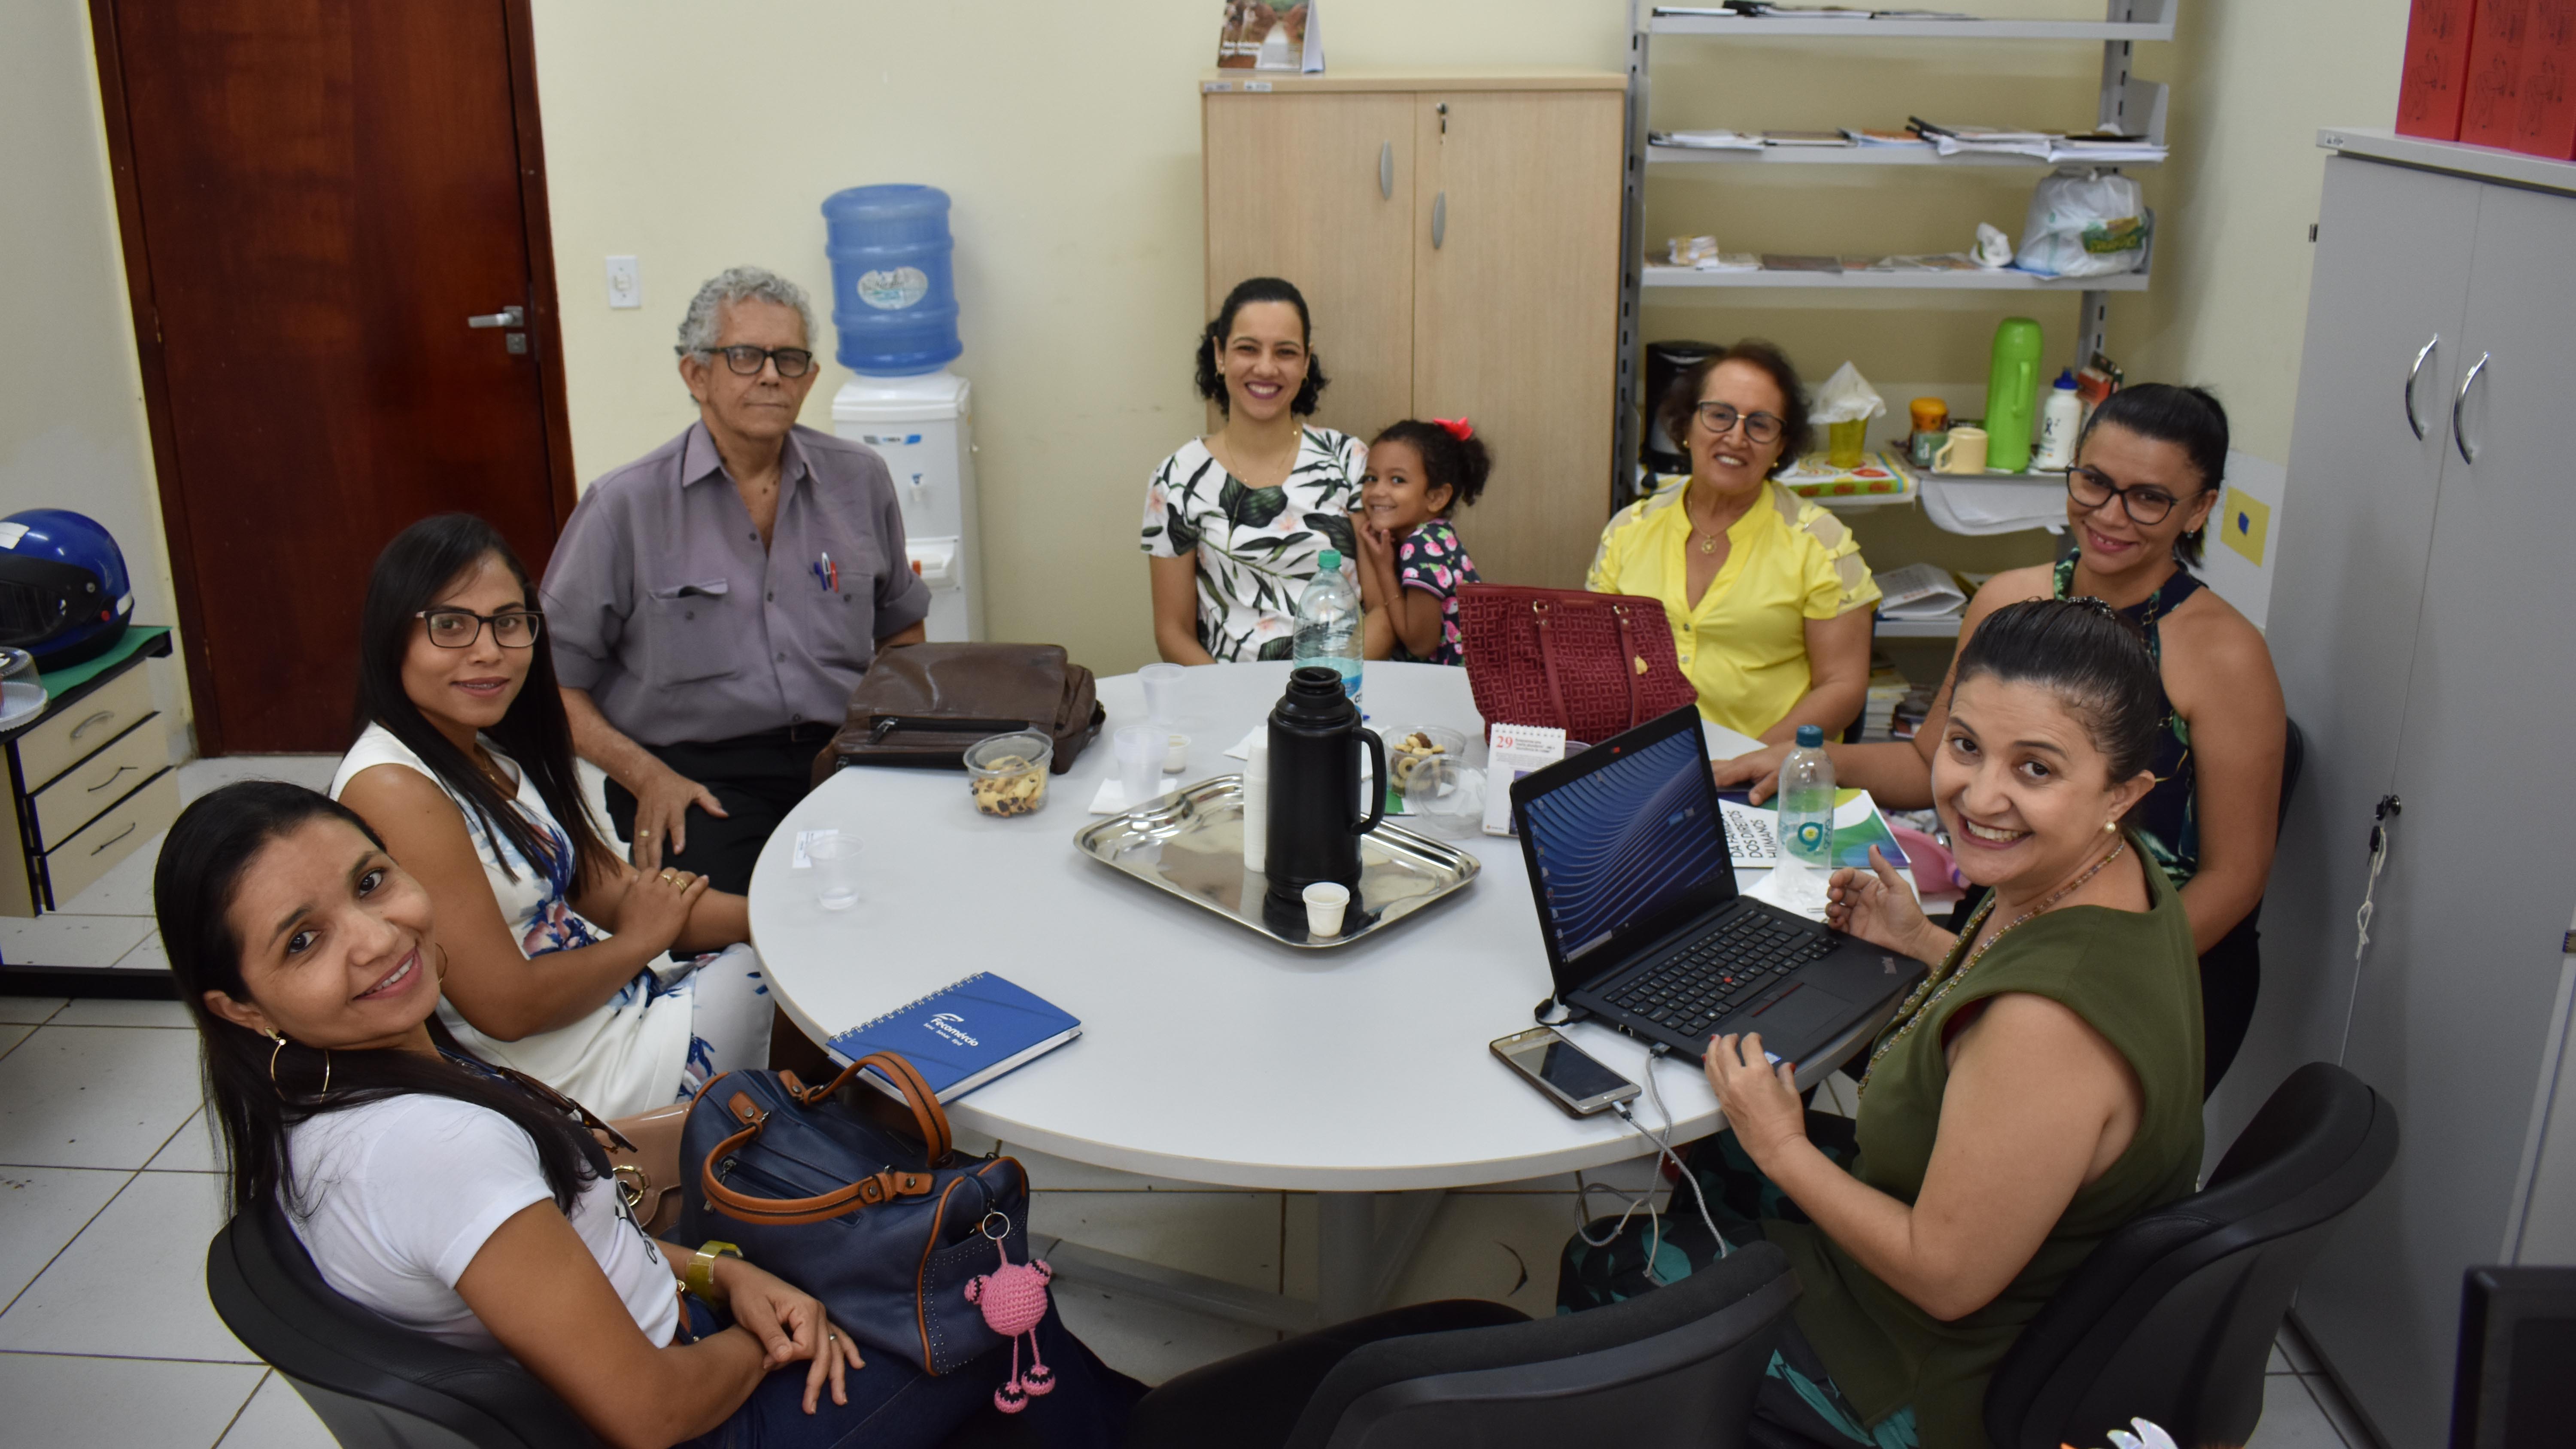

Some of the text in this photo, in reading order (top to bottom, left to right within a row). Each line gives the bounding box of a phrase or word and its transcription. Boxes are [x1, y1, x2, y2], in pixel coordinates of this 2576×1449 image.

[1496, 735, 1513, 748] 29
[1744, 840, 1763, 858] DOS
[1750, 819, 1777, 858] HUMANOS
[930, 1018, 978, 1046] Fecomércio
